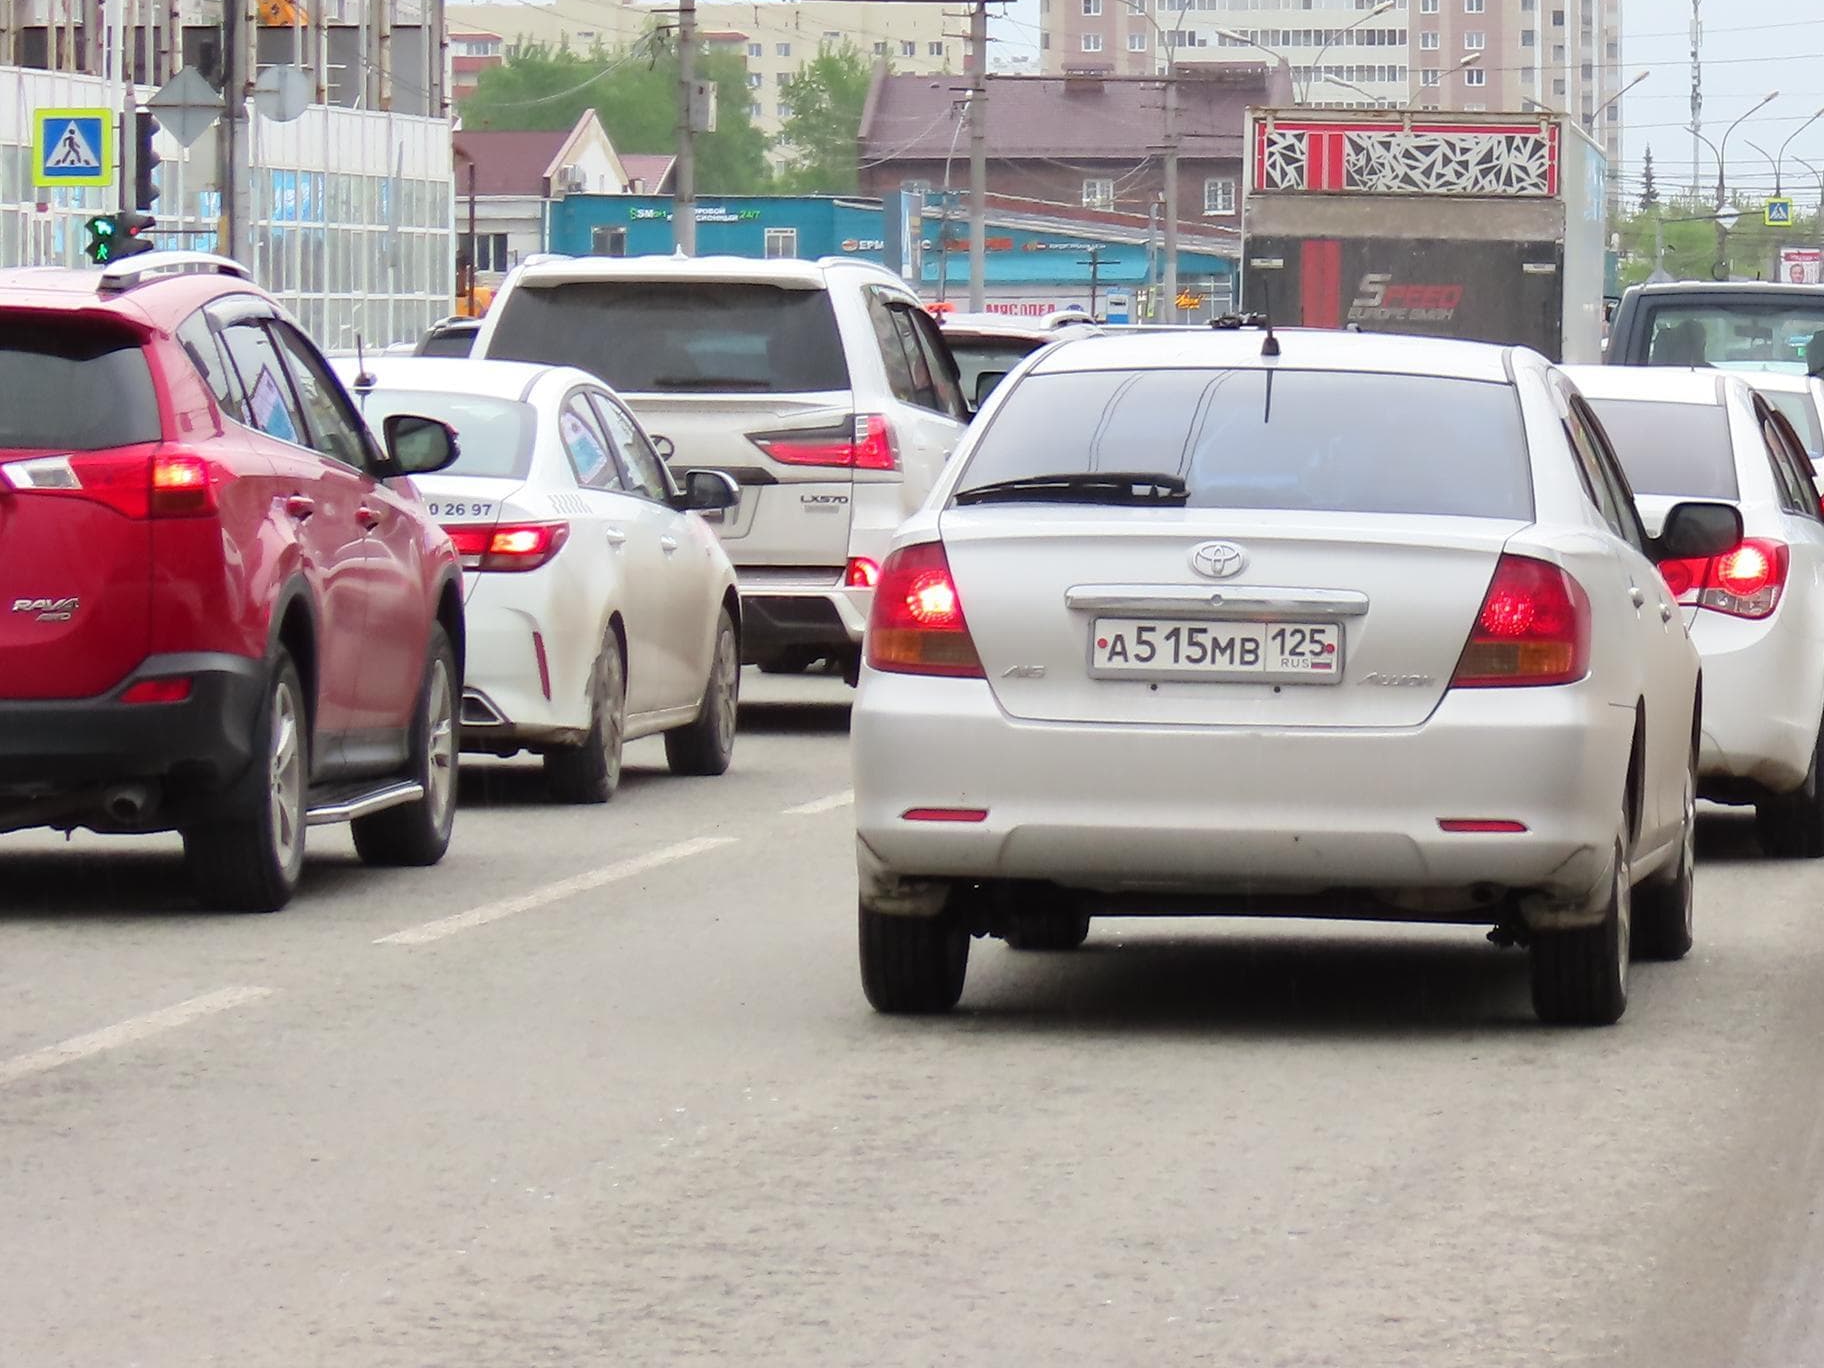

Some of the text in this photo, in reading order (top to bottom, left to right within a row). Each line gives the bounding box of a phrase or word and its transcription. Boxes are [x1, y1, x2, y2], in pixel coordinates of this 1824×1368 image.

[445, 503, 466, 516] 26
[470, 503, 492, 516] 97
[1106, 625, 1326, 667] А515МВ 125
[1280, 657, 1310, 669] RUS
